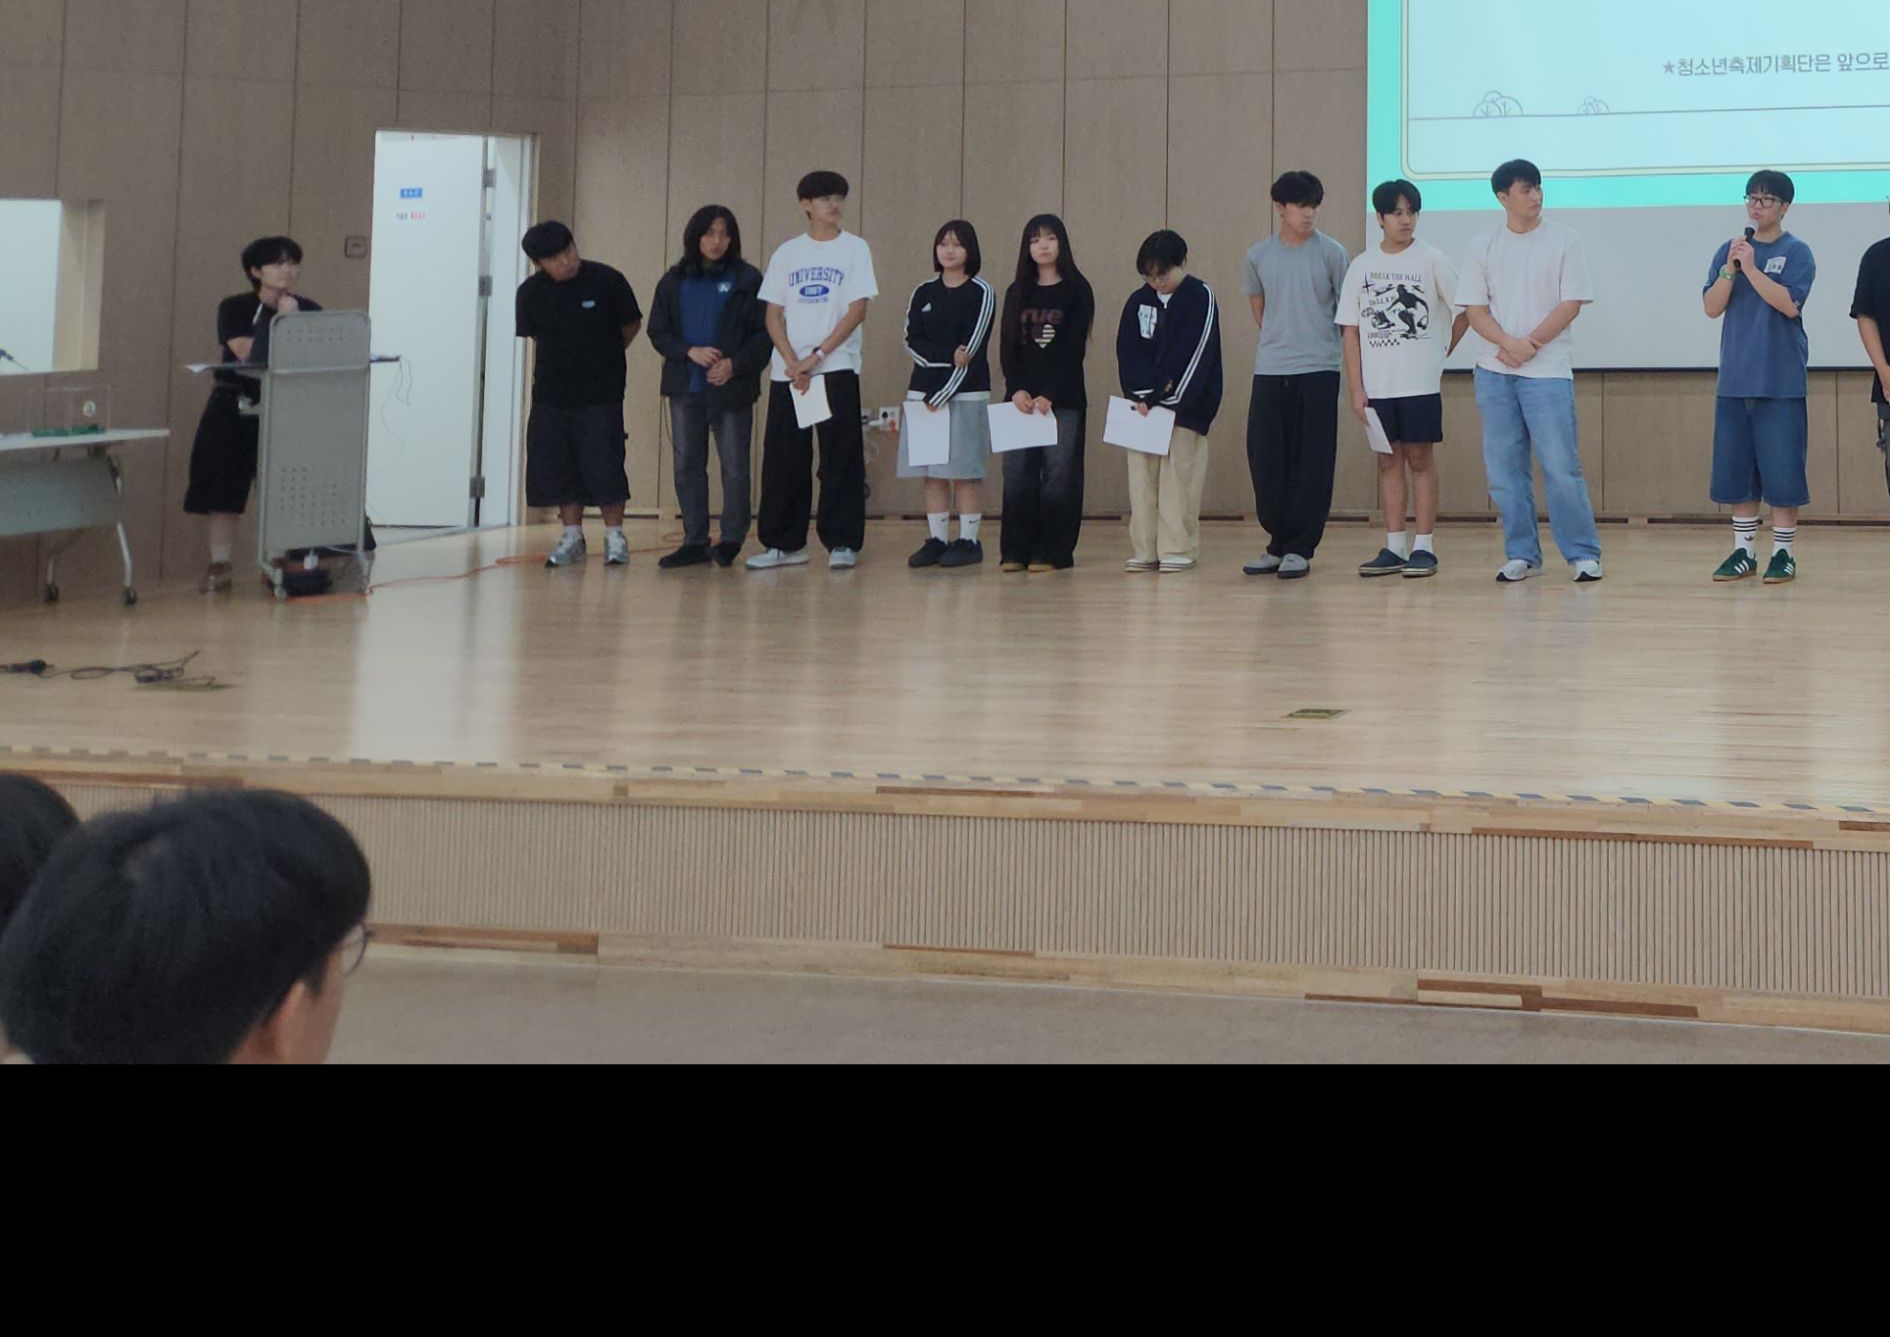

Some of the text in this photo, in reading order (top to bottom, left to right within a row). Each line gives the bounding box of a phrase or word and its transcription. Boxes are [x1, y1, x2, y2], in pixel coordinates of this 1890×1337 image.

[1677, 54, 1831, 77] 청소년축제기획단은
[1837, 51, 1890, 72] 앞으로
[789, 266, 845, 287] UNIVERSITY
